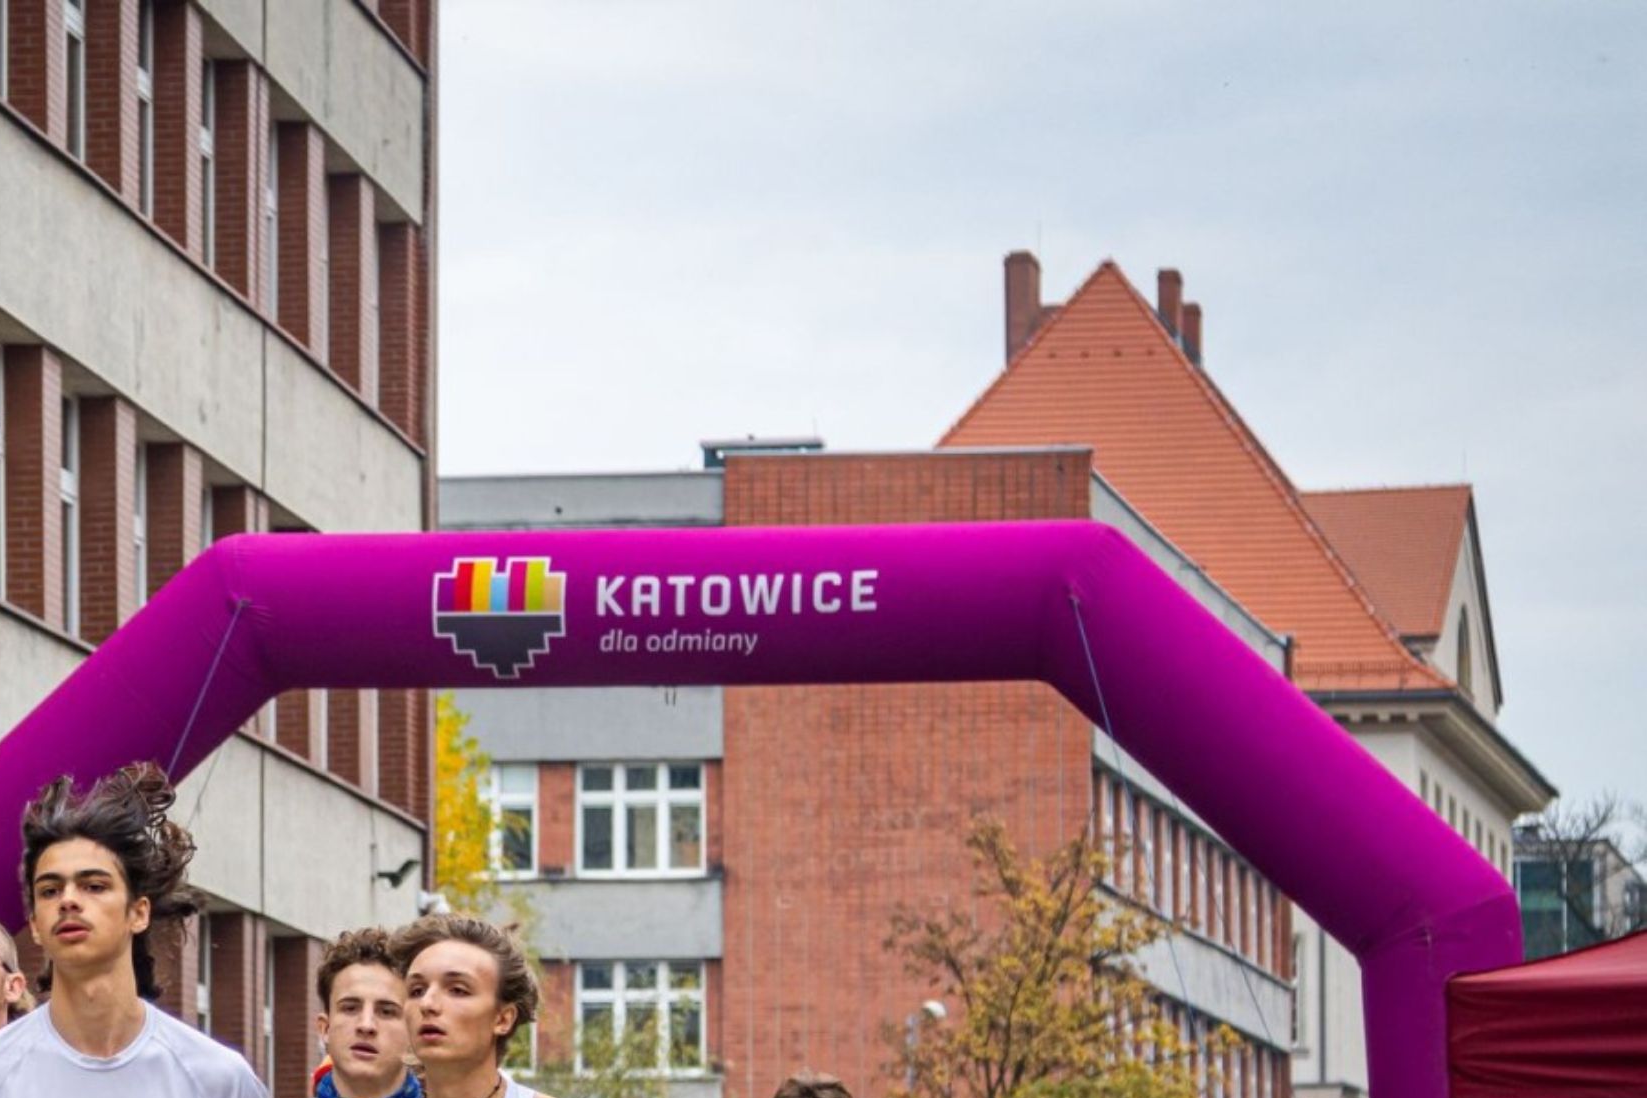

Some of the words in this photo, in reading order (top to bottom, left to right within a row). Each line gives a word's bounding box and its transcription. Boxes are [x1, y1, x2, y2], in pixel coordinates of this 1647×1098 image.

[596, 569, 879, 617] KATOWICE
[600, 628, 638, 652] dla
[645, 628, 759, 655] odmiany
